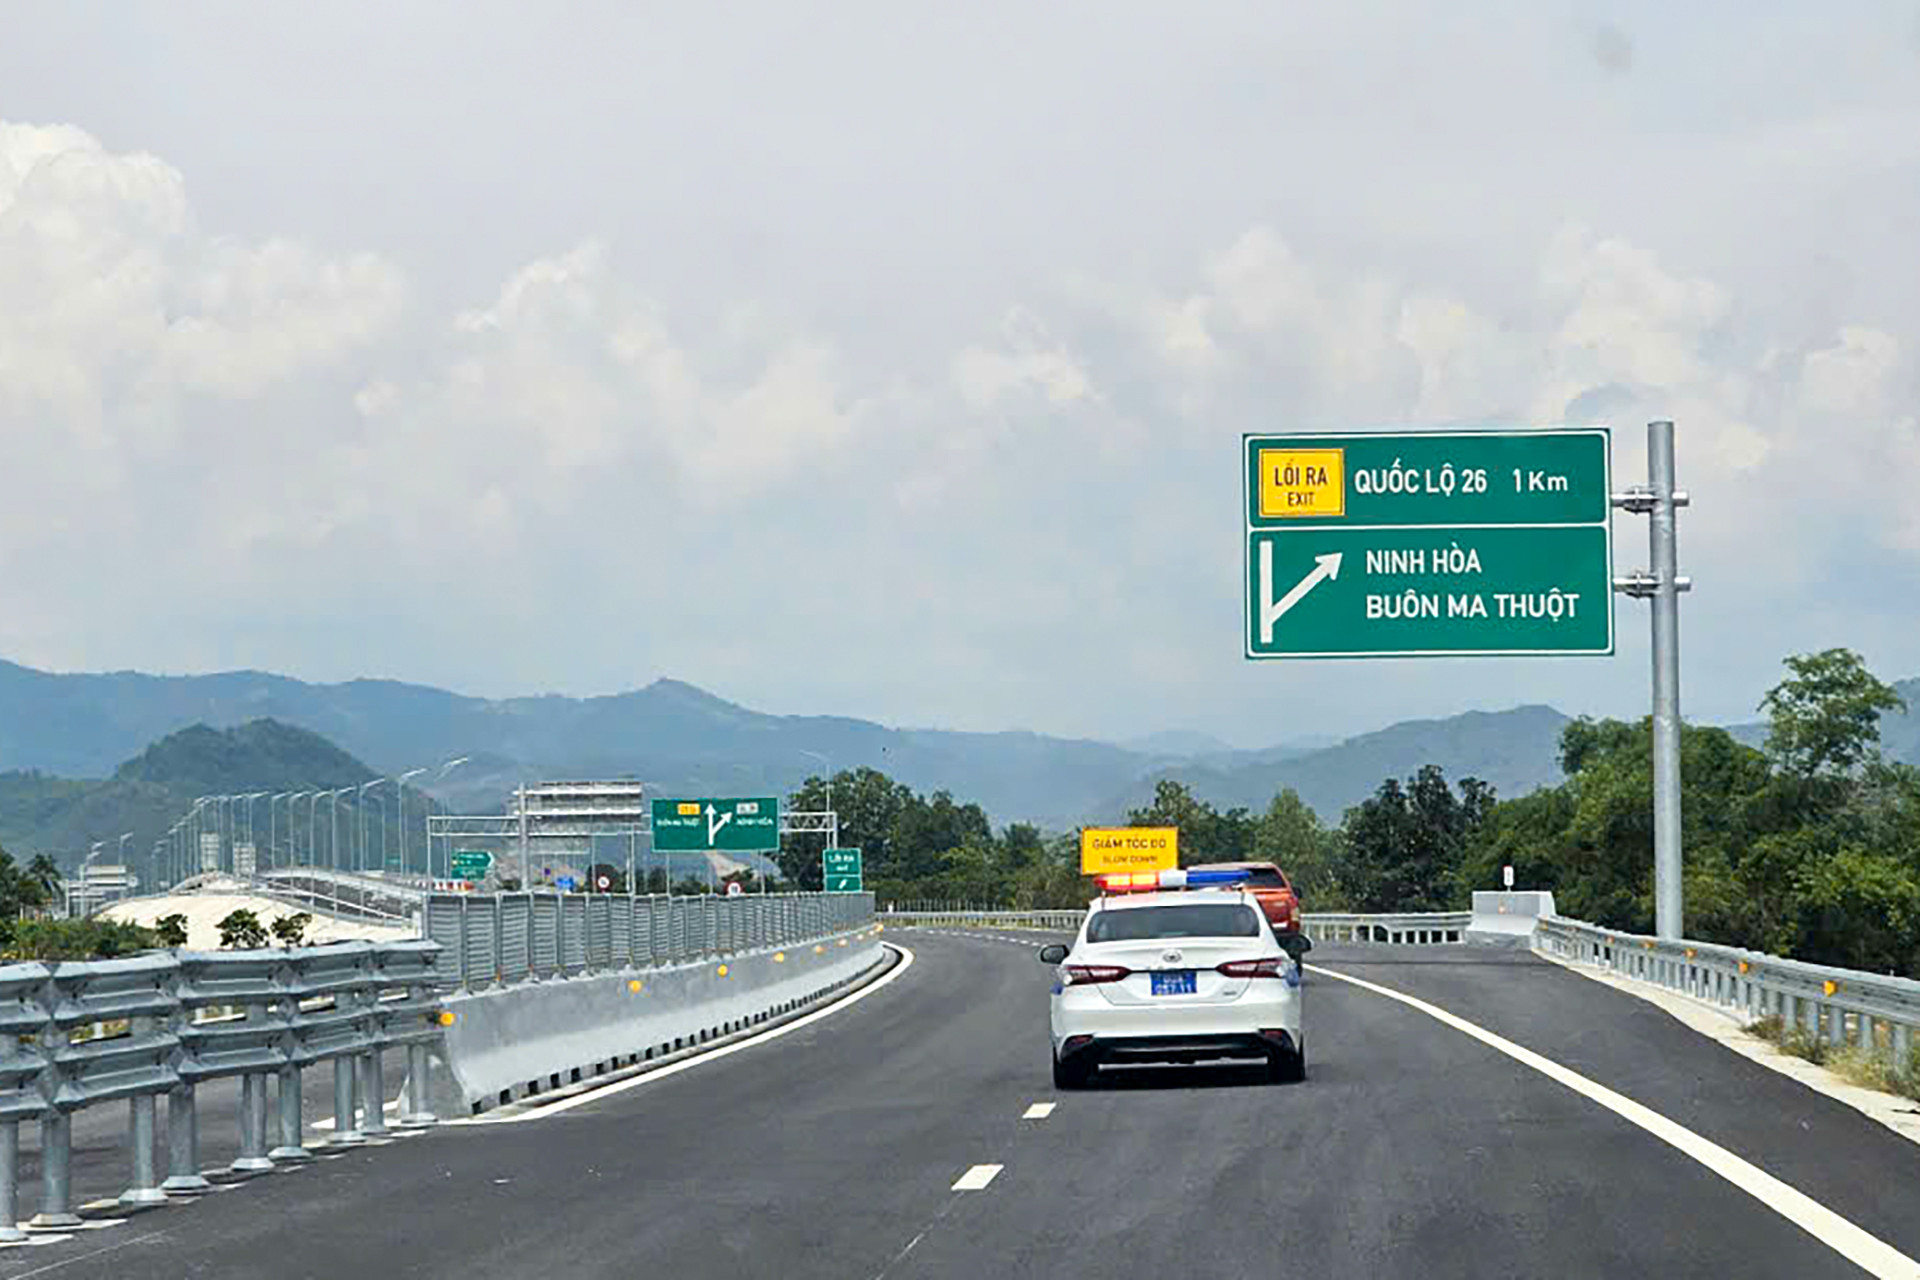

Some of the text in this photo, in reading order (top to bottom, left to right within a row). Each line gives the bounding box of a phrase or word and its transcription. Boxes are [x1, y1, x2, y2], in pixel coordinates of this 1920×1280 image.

[1275, 458, 1328, 487] LỐI RA
[1354, 457, 1488, 497] QUỐC LỘ 26
[1287, 491, 1315, 507] EXIT
[1366, 541, 1483, 575] NINH HÒA
[1366, 587, 1580, 622] BUÔN MA THUỘT
